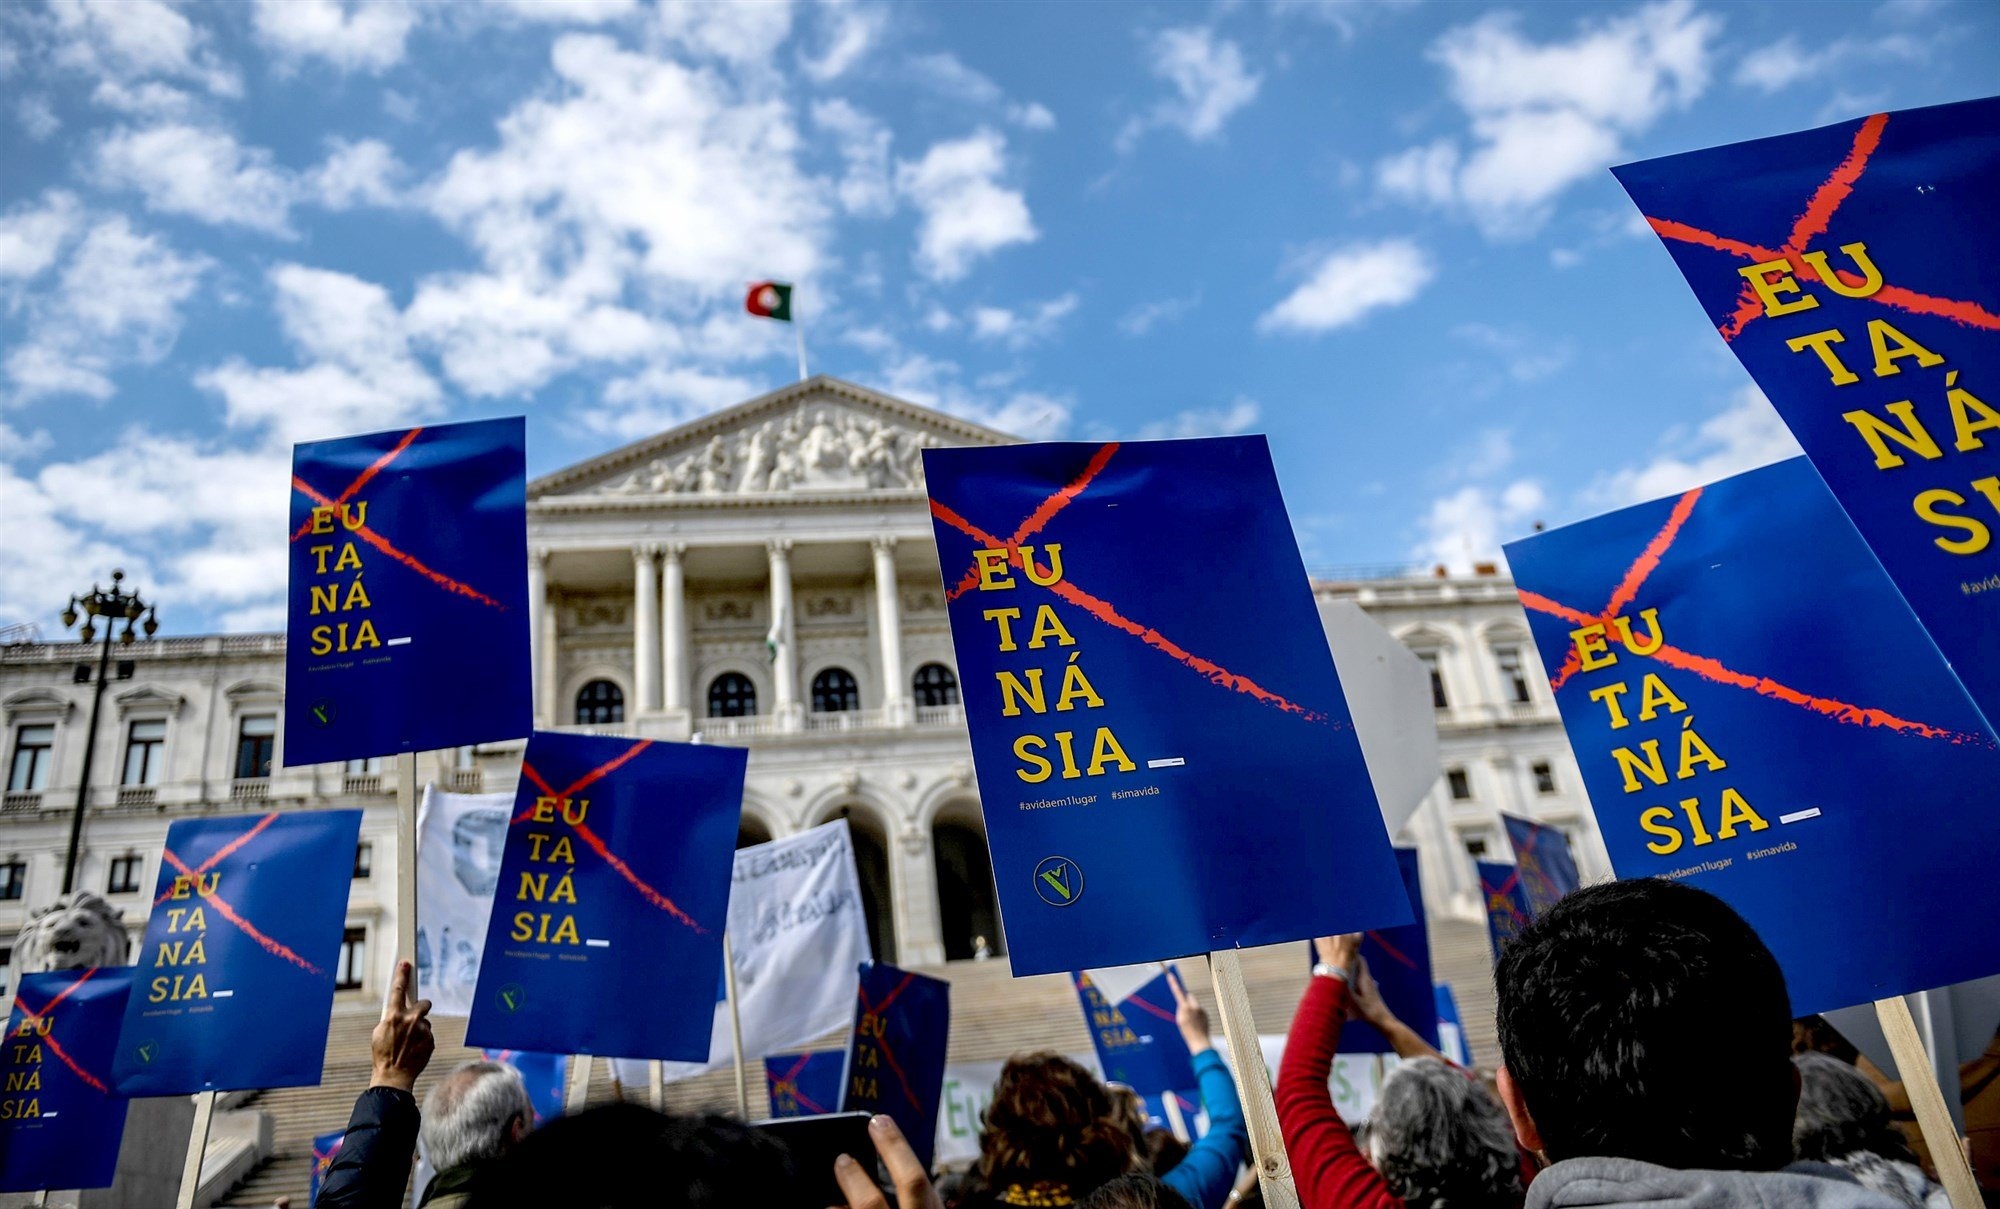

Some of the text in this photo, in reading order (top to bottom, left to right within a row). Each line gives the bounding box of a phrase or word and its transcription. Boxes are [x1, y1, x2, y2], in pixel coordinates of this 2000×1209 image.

[1737, 240, 1886, 320] EU
[1785, 318, 1946, 388] TA
[310, 500, 369, 535] EU
[309, 541, 363, 574] TA
[972, 542, 1066, 592] EU
[309, 572, 371, 615] NÁ
[982, 604, 1077, 652] TA
[1568, 607, 1665, 674] EU
[994, 651, 1106, 718] NÁ
[1589, 672, 1687, 730] TA
[1610, 715, 1728, 794] NÁ
[531, 796, 590, 826] EU
[1018, 784, 1160, 811] #avidaem1lugar #simavida
[526, 832, 576, 865] TA
[1746, 841, 1798, 861] #simavida
[171, 872, 222, 901] EU
[515, 867, 578, 904] NÁ
[166, 907, 207, 934] TA
[154, 934, 207, 968] NÁ
[17, 1015, 54, 1037] EU
[13, 1043, 43, 1064] TA
[5, 1065, 42, 1092] NÁ
